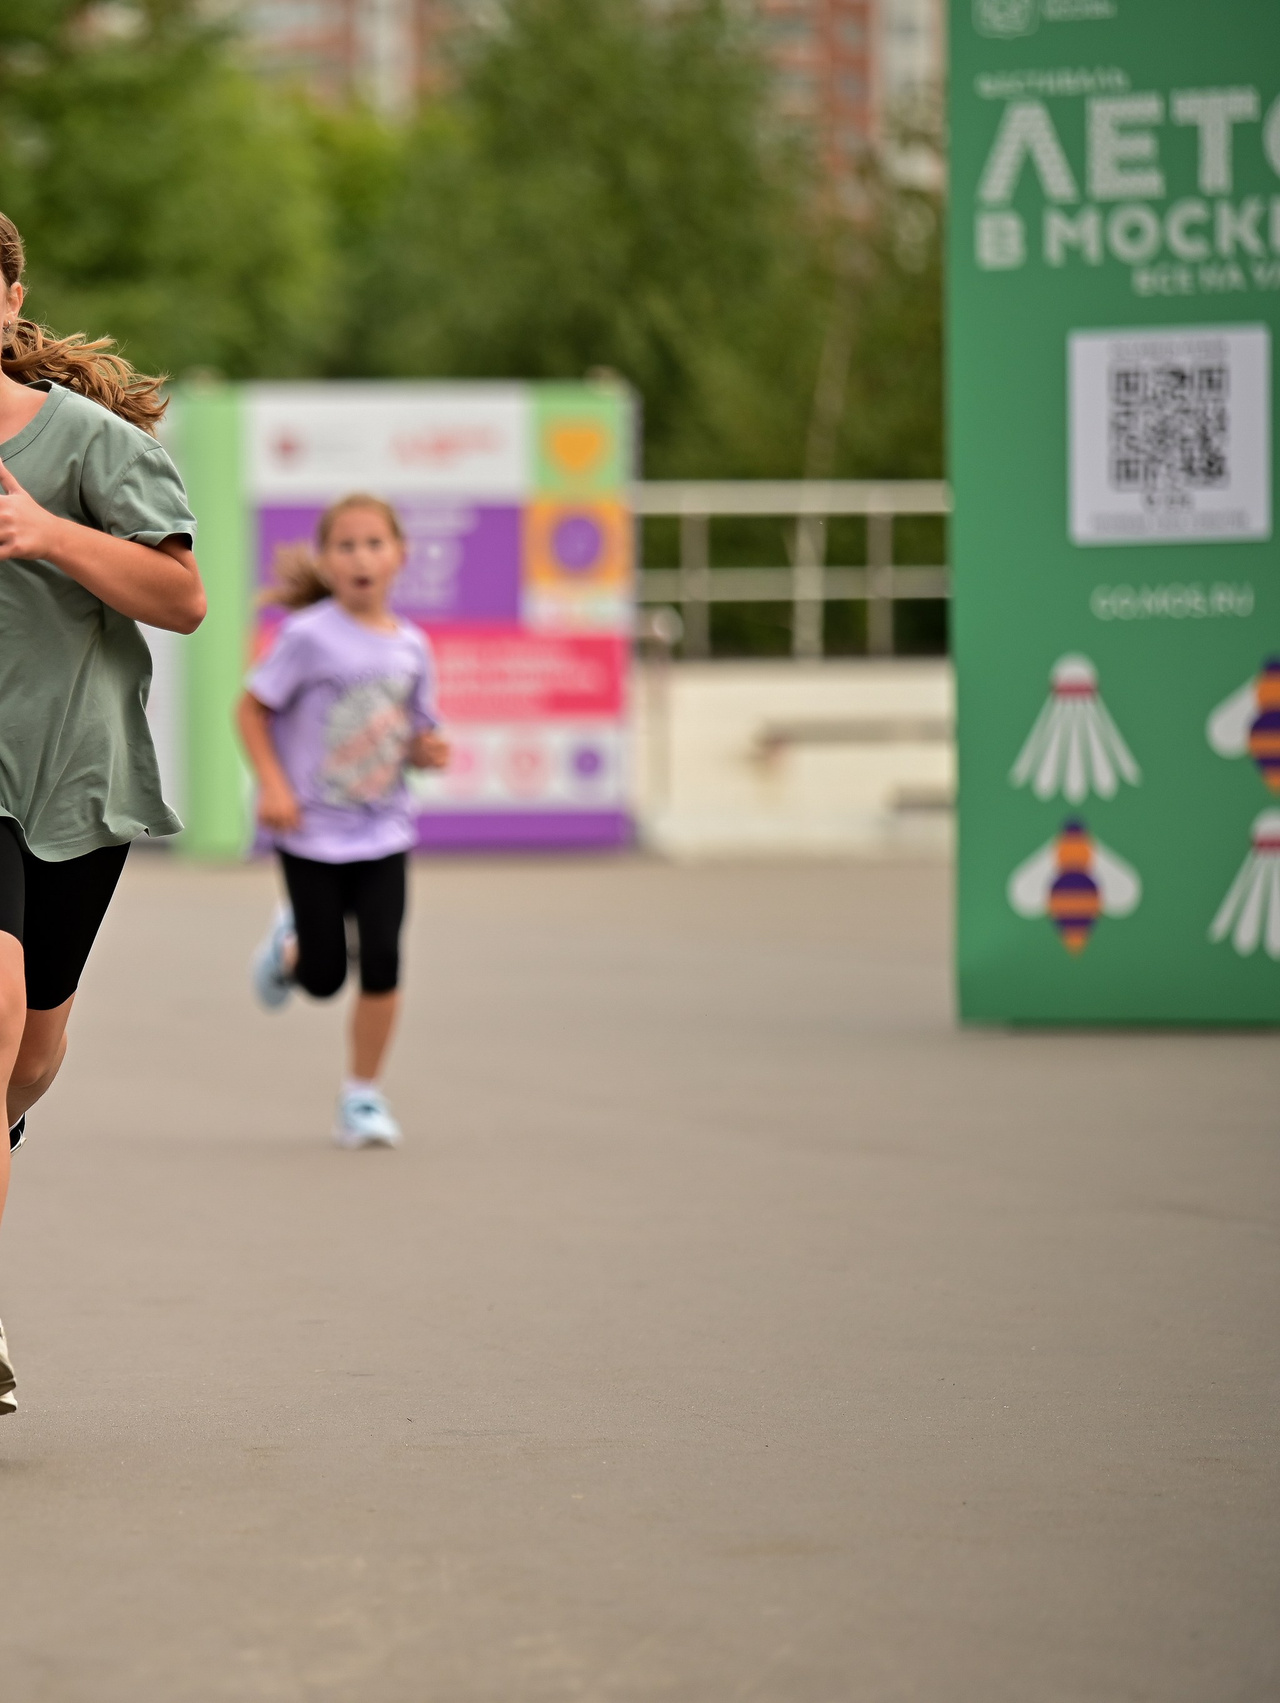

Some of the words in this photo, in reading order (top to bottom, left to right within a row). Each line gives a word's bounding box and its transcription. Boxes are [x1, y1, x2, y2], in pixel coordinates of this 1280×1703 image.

[978, 87, 1280, 203] ЛЕТ
[976, 211, 1024, 269] В
[1043, 196, 1280, 266] МОСК
[1133, 266, 1193, 294] ВСЕ
[1199, 263, 1247, 291] НА
